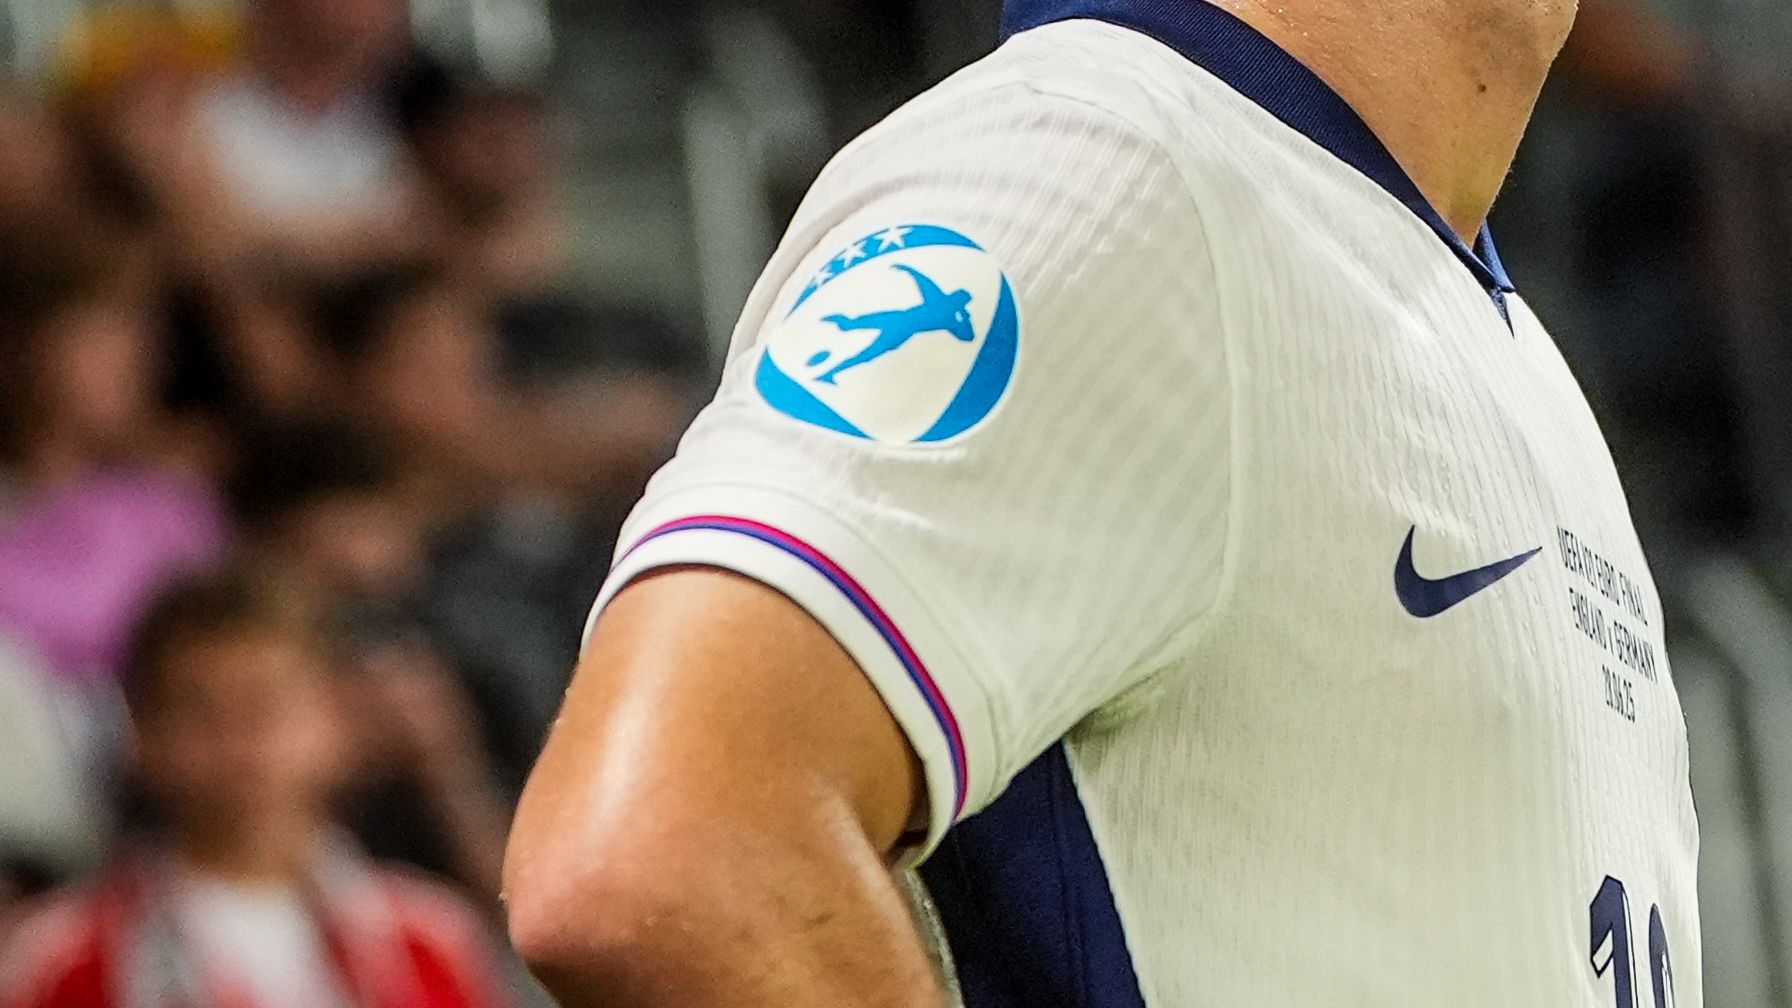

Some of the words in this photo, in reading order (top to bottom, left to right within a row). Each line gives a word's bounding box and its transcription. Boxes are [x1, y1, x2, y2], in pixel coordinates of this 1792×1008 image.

[1556, 525, 1585, 578] UEFA
[1595, 554, 1620, 606] EURO
[1619, 571, 1648, 627] FINAL
[1569, 587, 1606, 649] ENGLAND
[1613, 619, 1658, 684] GERMANY
